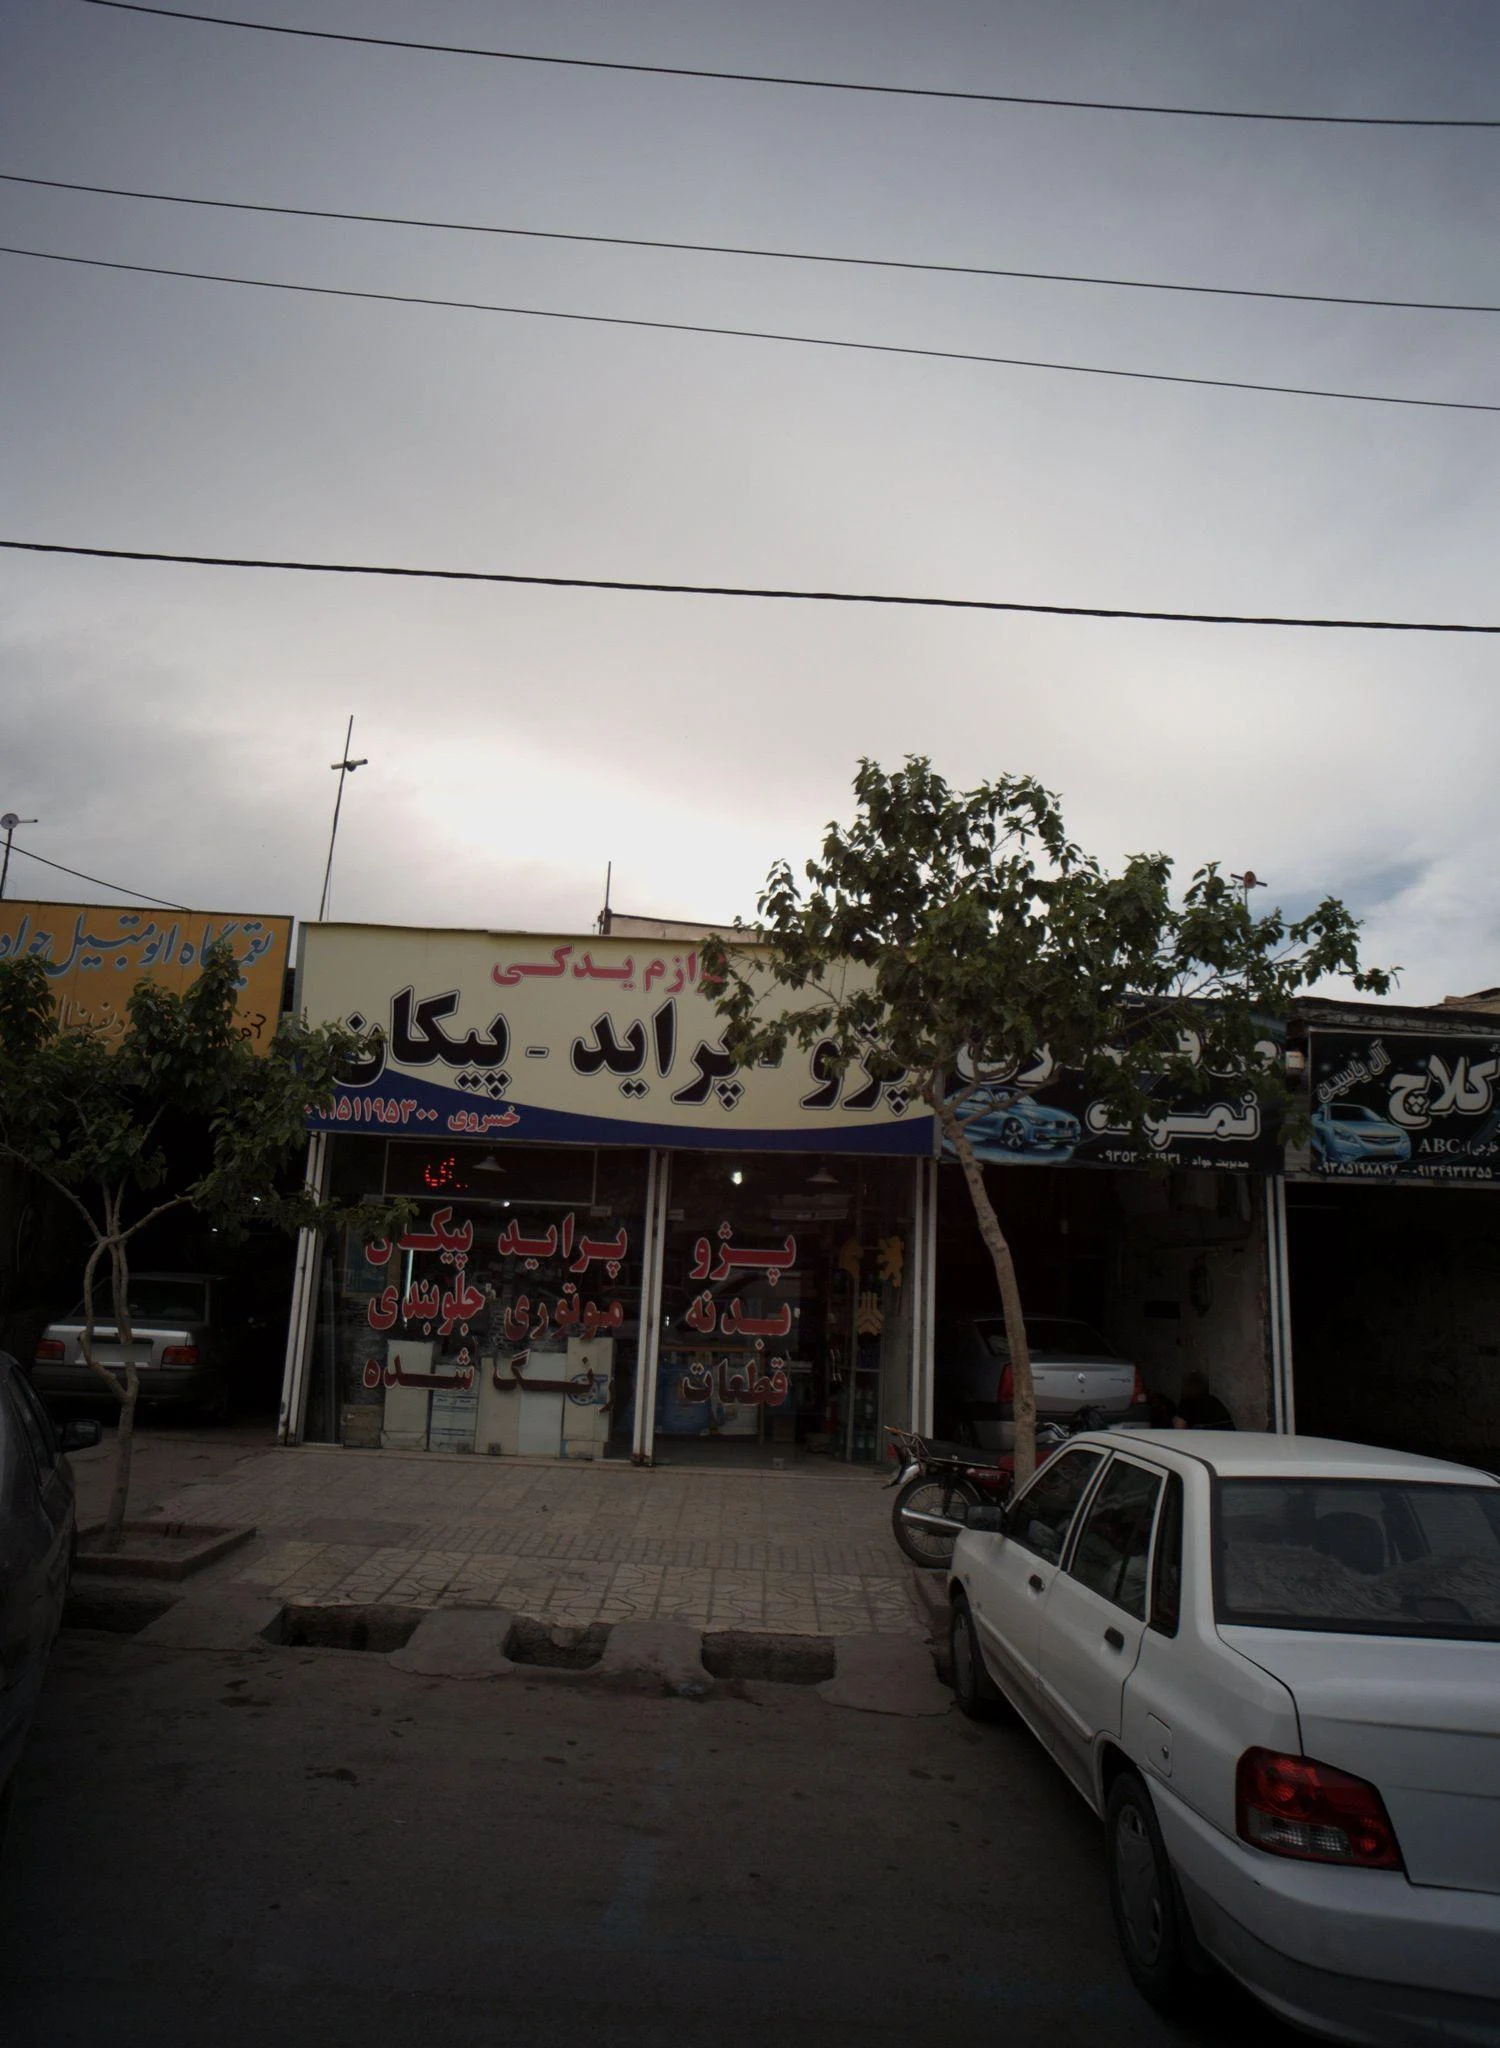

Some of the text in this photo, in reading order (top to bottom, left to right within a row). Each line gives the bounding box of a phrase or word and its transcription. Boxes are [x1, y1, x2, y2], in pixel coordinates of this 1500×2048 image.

[491, 944, 728, 995] ازم یدکی
[329, 985, 512, 1100] پیکان
[571, 996, 746, 1111] پراید
[447, 1105, 521, 1133] خسروی
[1387, 1053, 1500, 1130] کلاچ
[497, 1212, 628, 1279] پراید
[689, 1220, 797, 1286] پژو
[368, 1269, 793, 1350] بدنه موتوری جلوبندی
[363, 1346, 476, 1392] شده
[682, 1357, 789, 1407] قطعات
